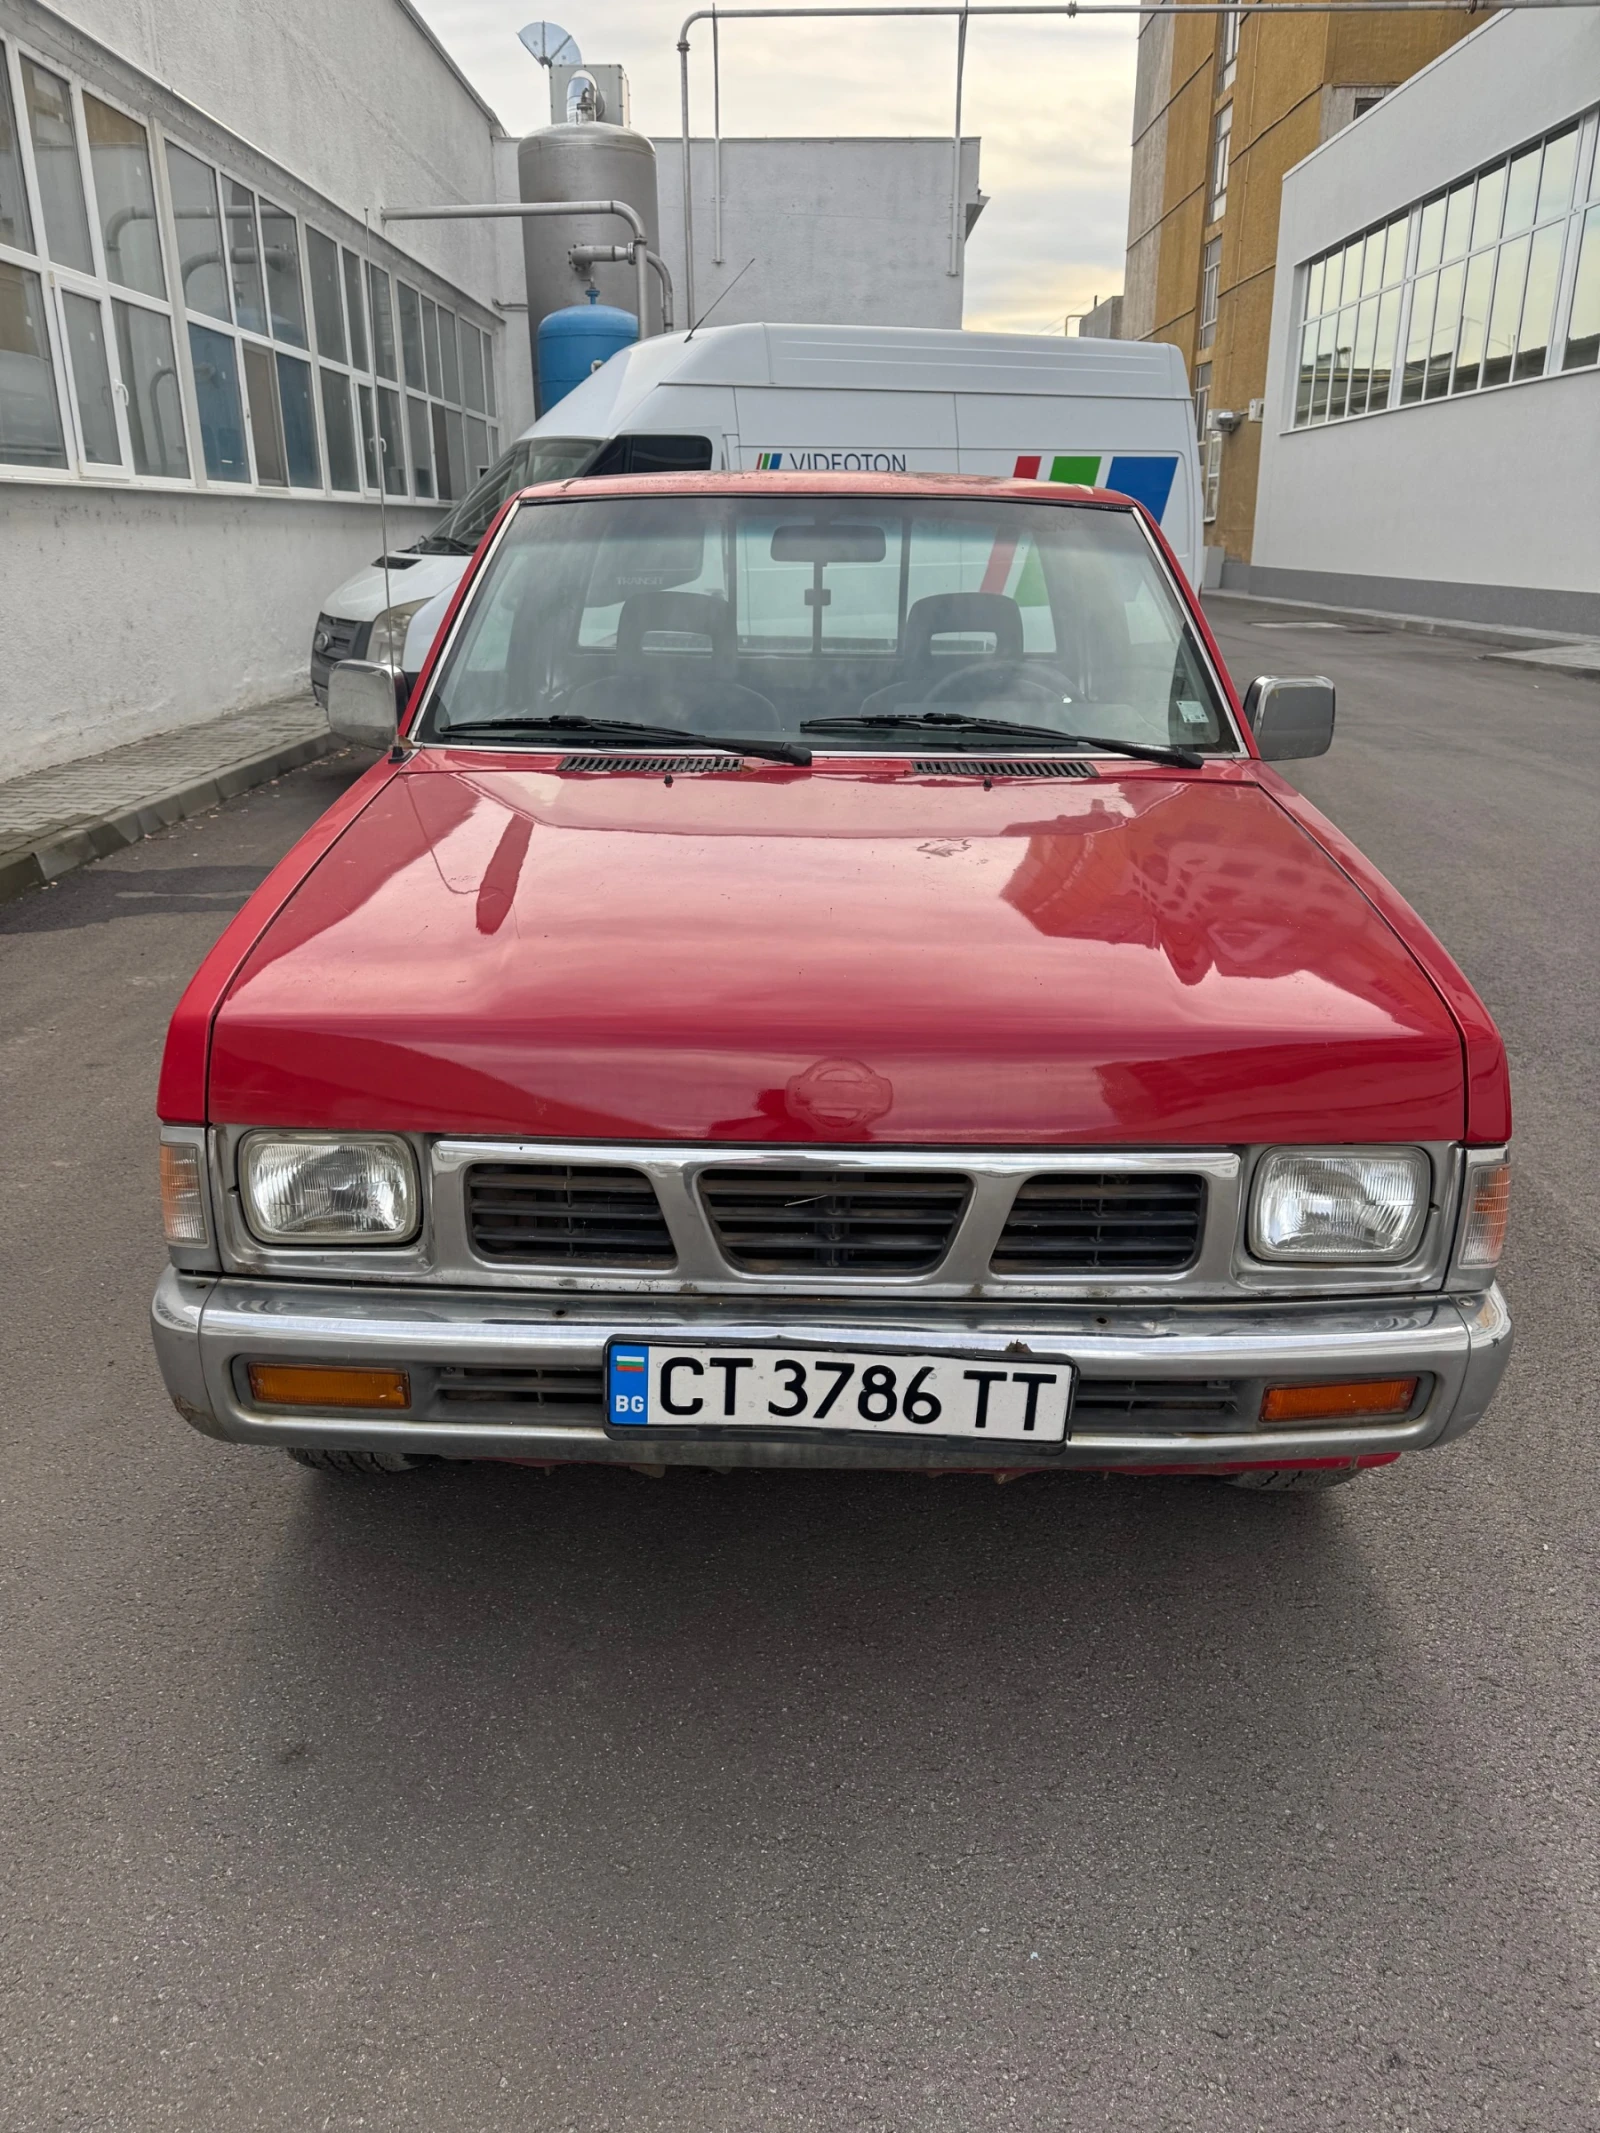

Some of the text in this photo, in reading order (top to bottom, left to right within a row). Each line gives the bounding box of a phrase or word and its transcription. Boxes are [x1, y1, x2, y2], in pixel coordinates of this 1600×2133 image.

[789, 452, 907, 472] VIDEOTON
[615, 1394, 645, 1413] BG
[659, 1356, 1057, 1431] CT 3786 TT
